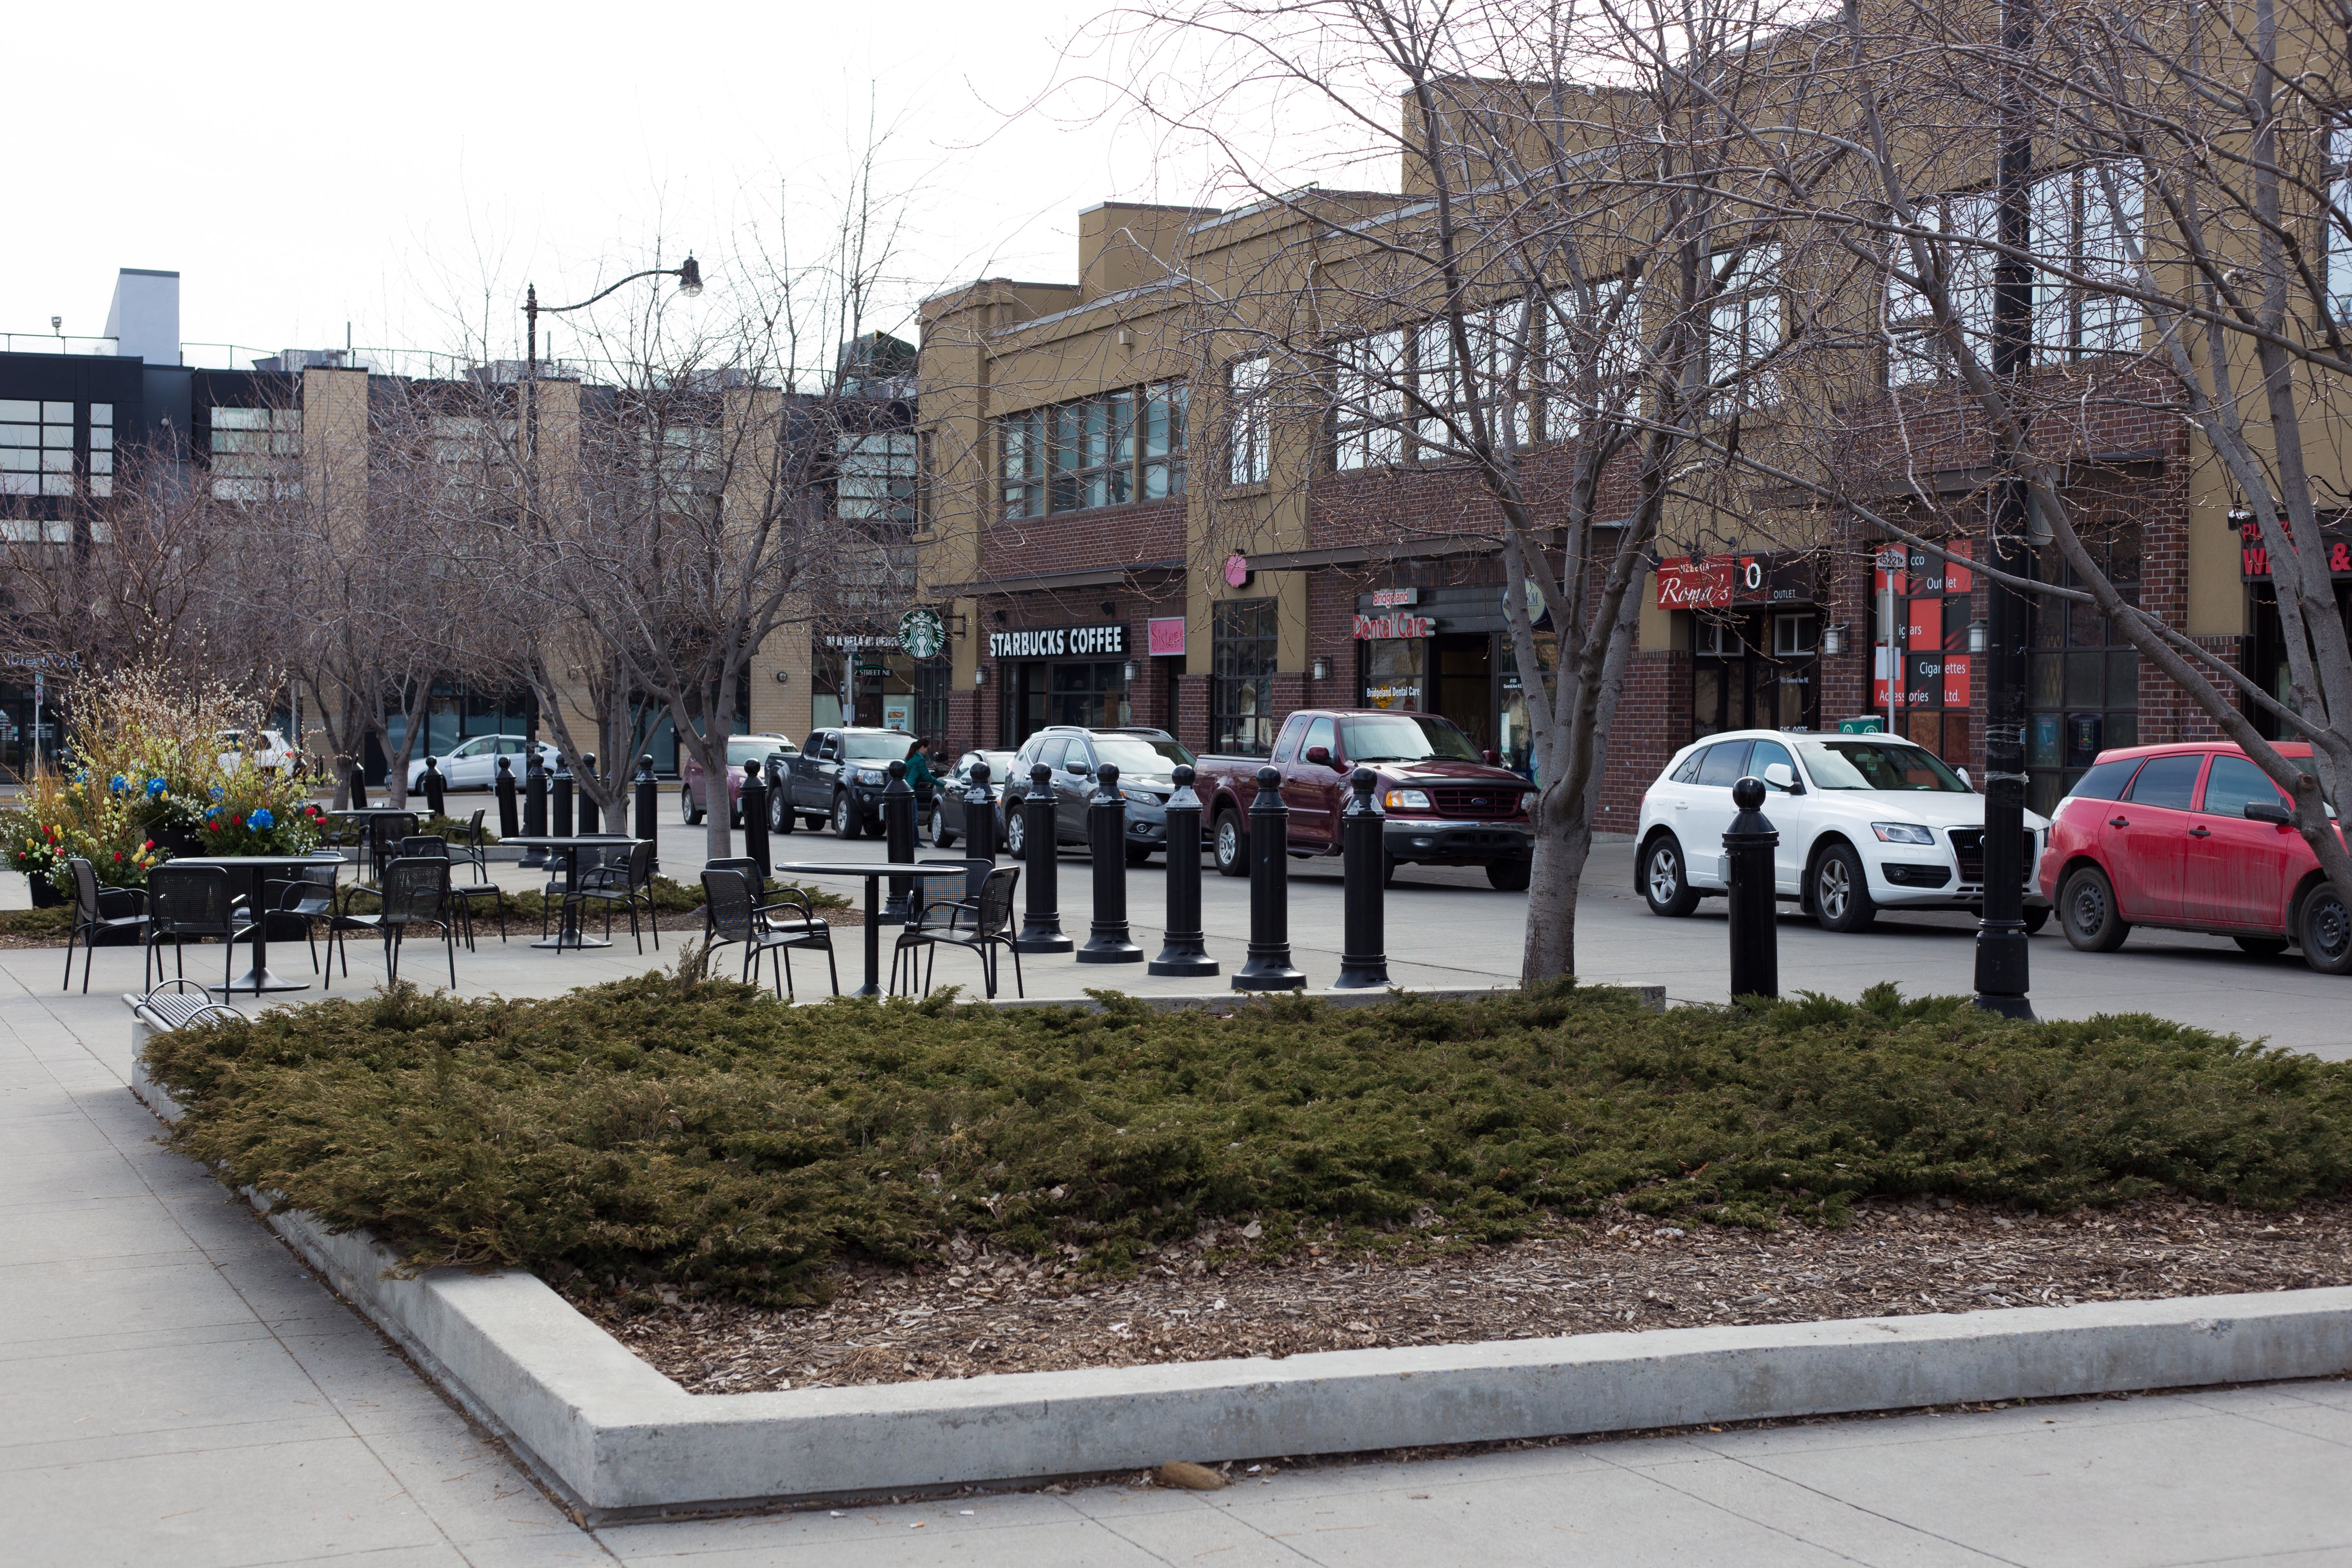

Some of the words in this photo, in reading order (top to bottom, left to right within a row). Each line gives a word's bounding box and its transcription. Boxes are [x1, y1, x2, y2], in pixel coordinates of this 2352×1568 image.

[1882, 556, 1901, 565] 5221
[1660, 574, 1730, 604] Roma's
[1773, 590, 1795, 599] OUTLET
[1373, 590, 1409, 607] Bridgeland
[1353, 613, 1393, 640] Dental
[1398, 613, 1427, 638] Care
[1899, 624, 1922, 639] igars
[990, 629, 1064, 657] STARBUCKS
[1070, 626, 1122, 654] COFFEE
[1367, 687, 1391, 699] Bridgeland
[1392, 686, 1408, 697] Dental
[1409, 686, 1420, 696] Care
[1879, 689, 1929, 702] Acessories
[1944, 689, 1960, 702] Ltd.
